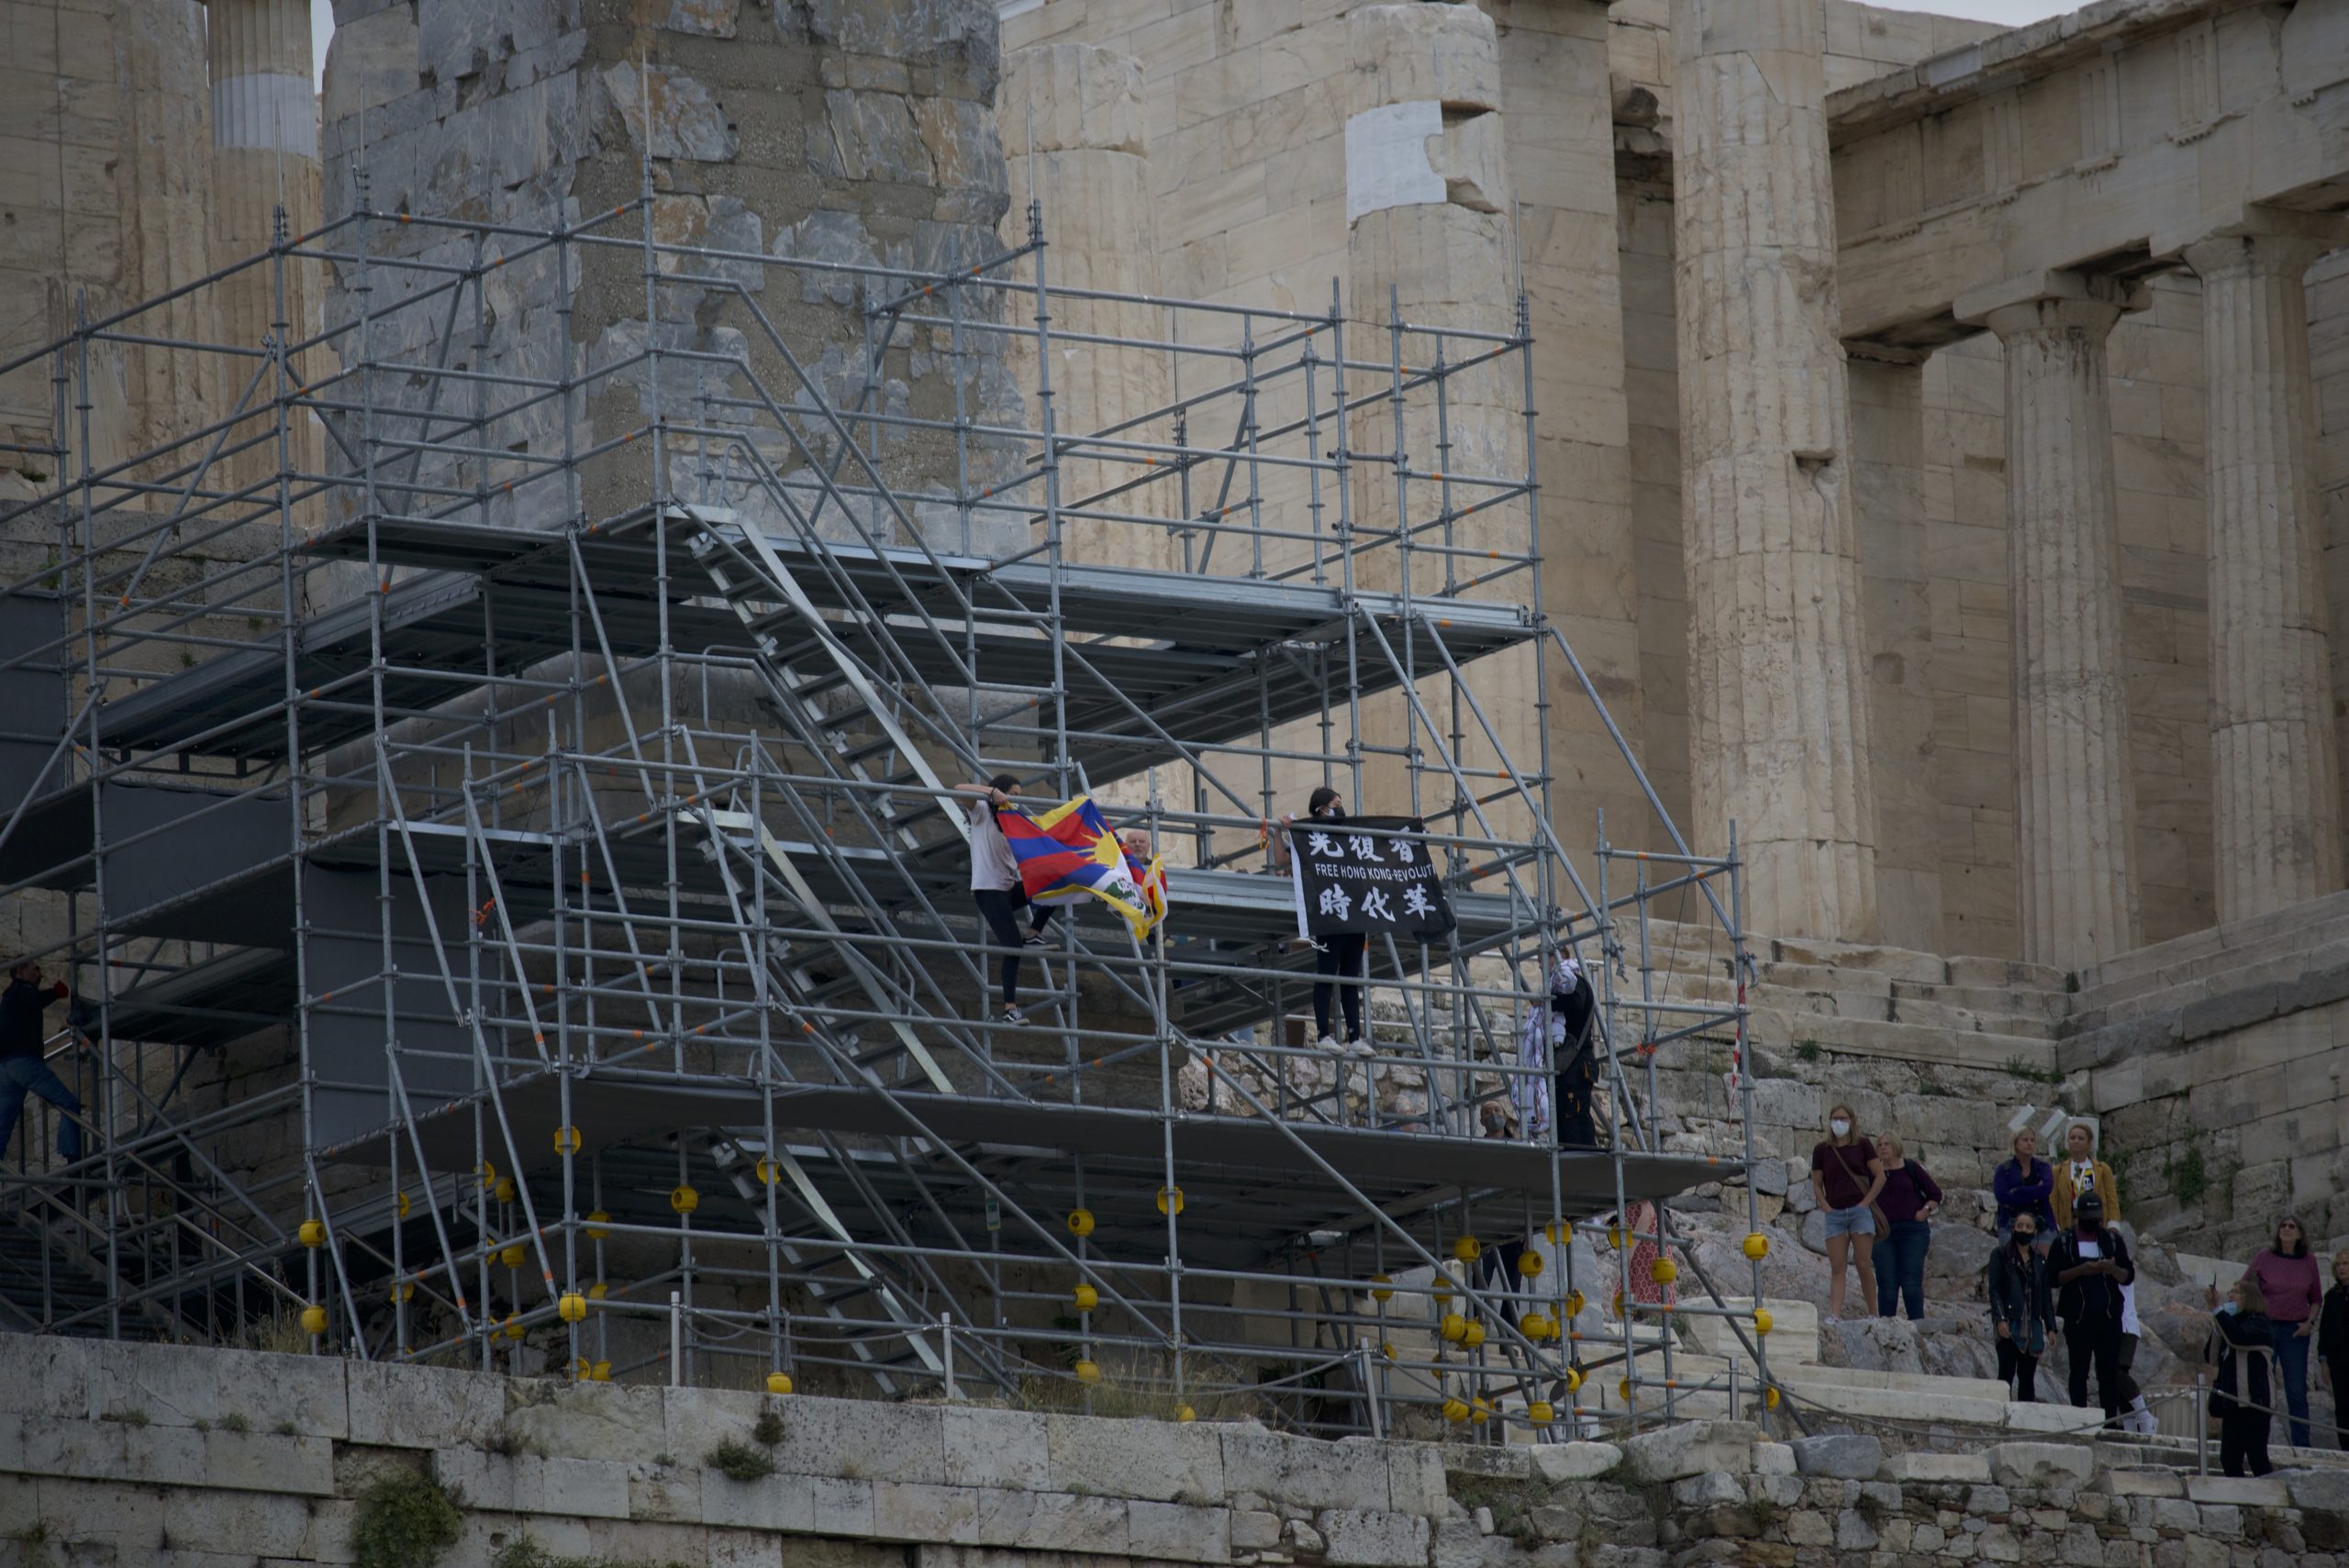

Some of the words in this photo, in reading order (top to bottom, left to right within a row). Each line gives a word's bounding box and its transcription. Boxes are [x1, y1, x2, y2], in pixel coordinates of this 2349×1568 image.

[1315, 863, 1339, 878] FREE
[1341, 865, 1367, 880] HONG
[1319, 883, 1437, 923] 時代革
